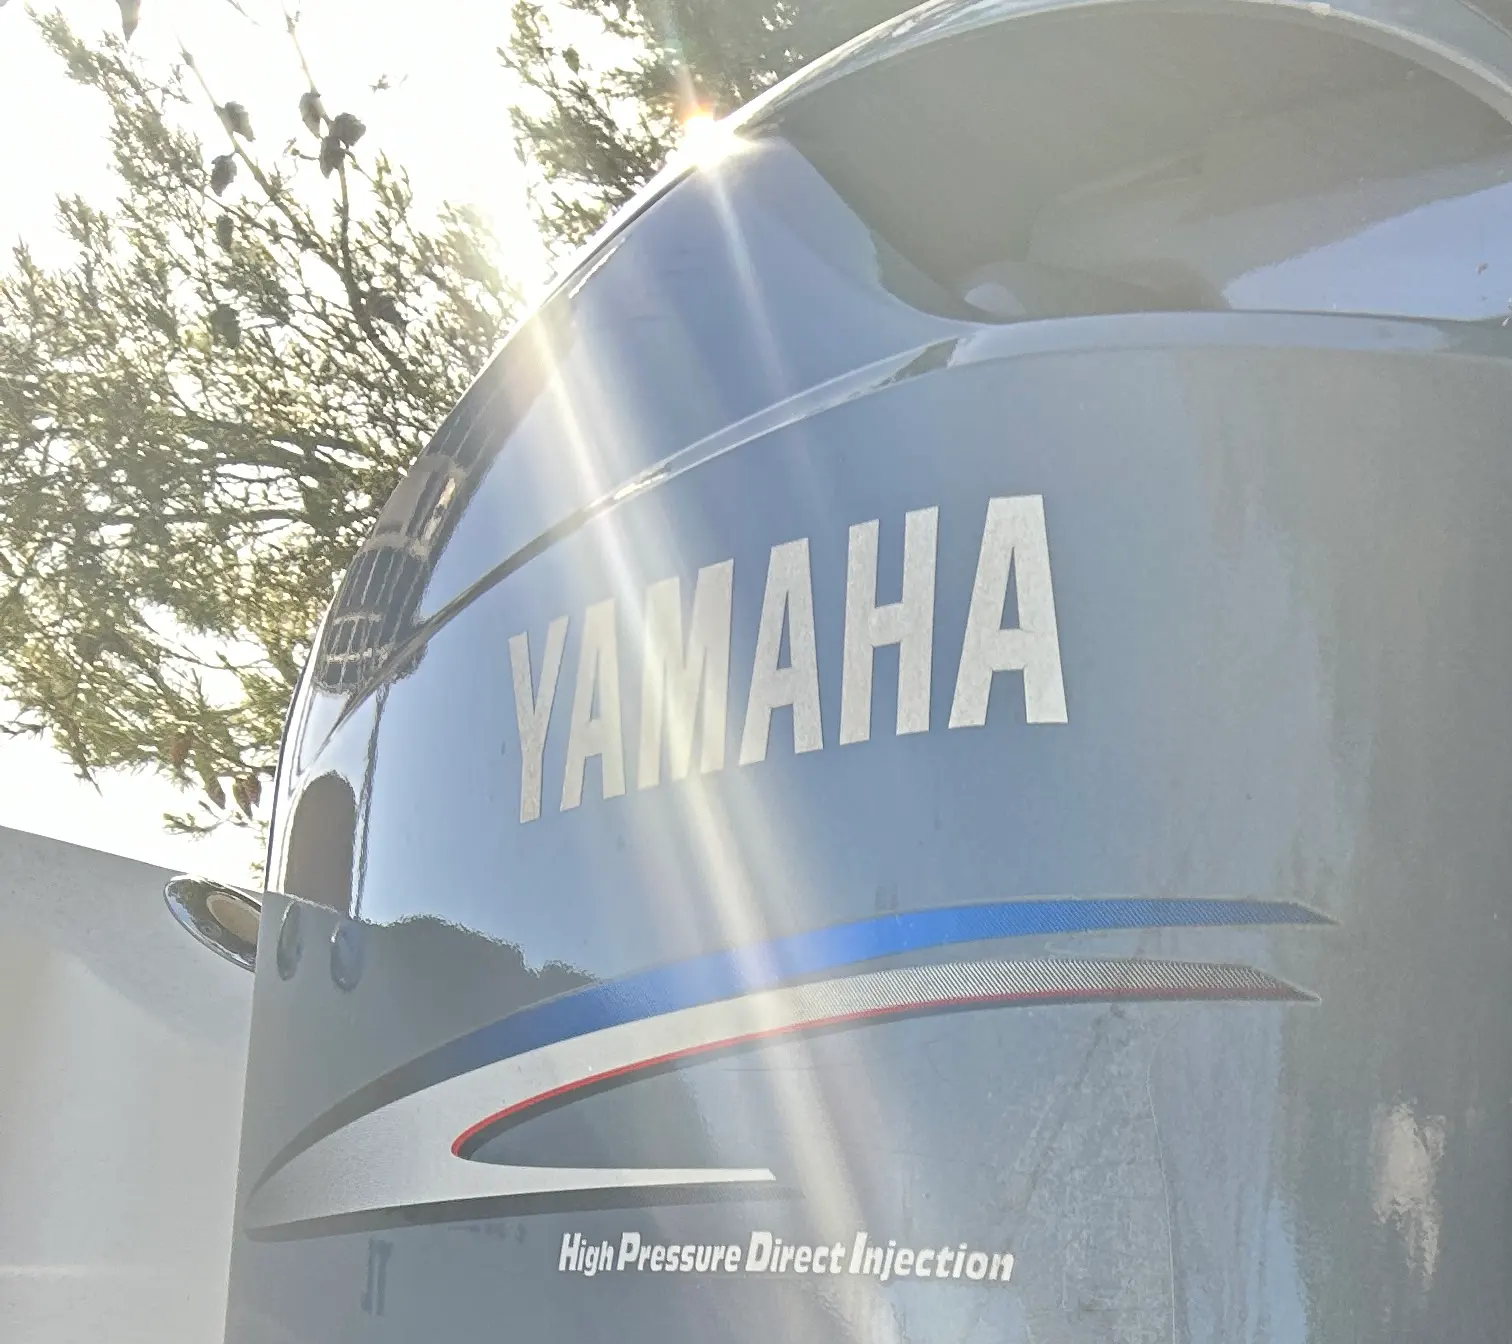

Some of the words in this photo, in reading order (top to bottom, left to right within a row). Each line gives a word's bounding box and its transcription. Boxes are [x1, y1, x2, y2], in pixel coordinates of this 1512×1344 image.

[508, 493, 1070, 825] YAMAHA
[558, 1232, 613, 1277] High
[616, 1231, 742, 1273] Pressure
[745, 1231, 844, 1275] Direct
[847, 1231, 1016, 1283] Injection
